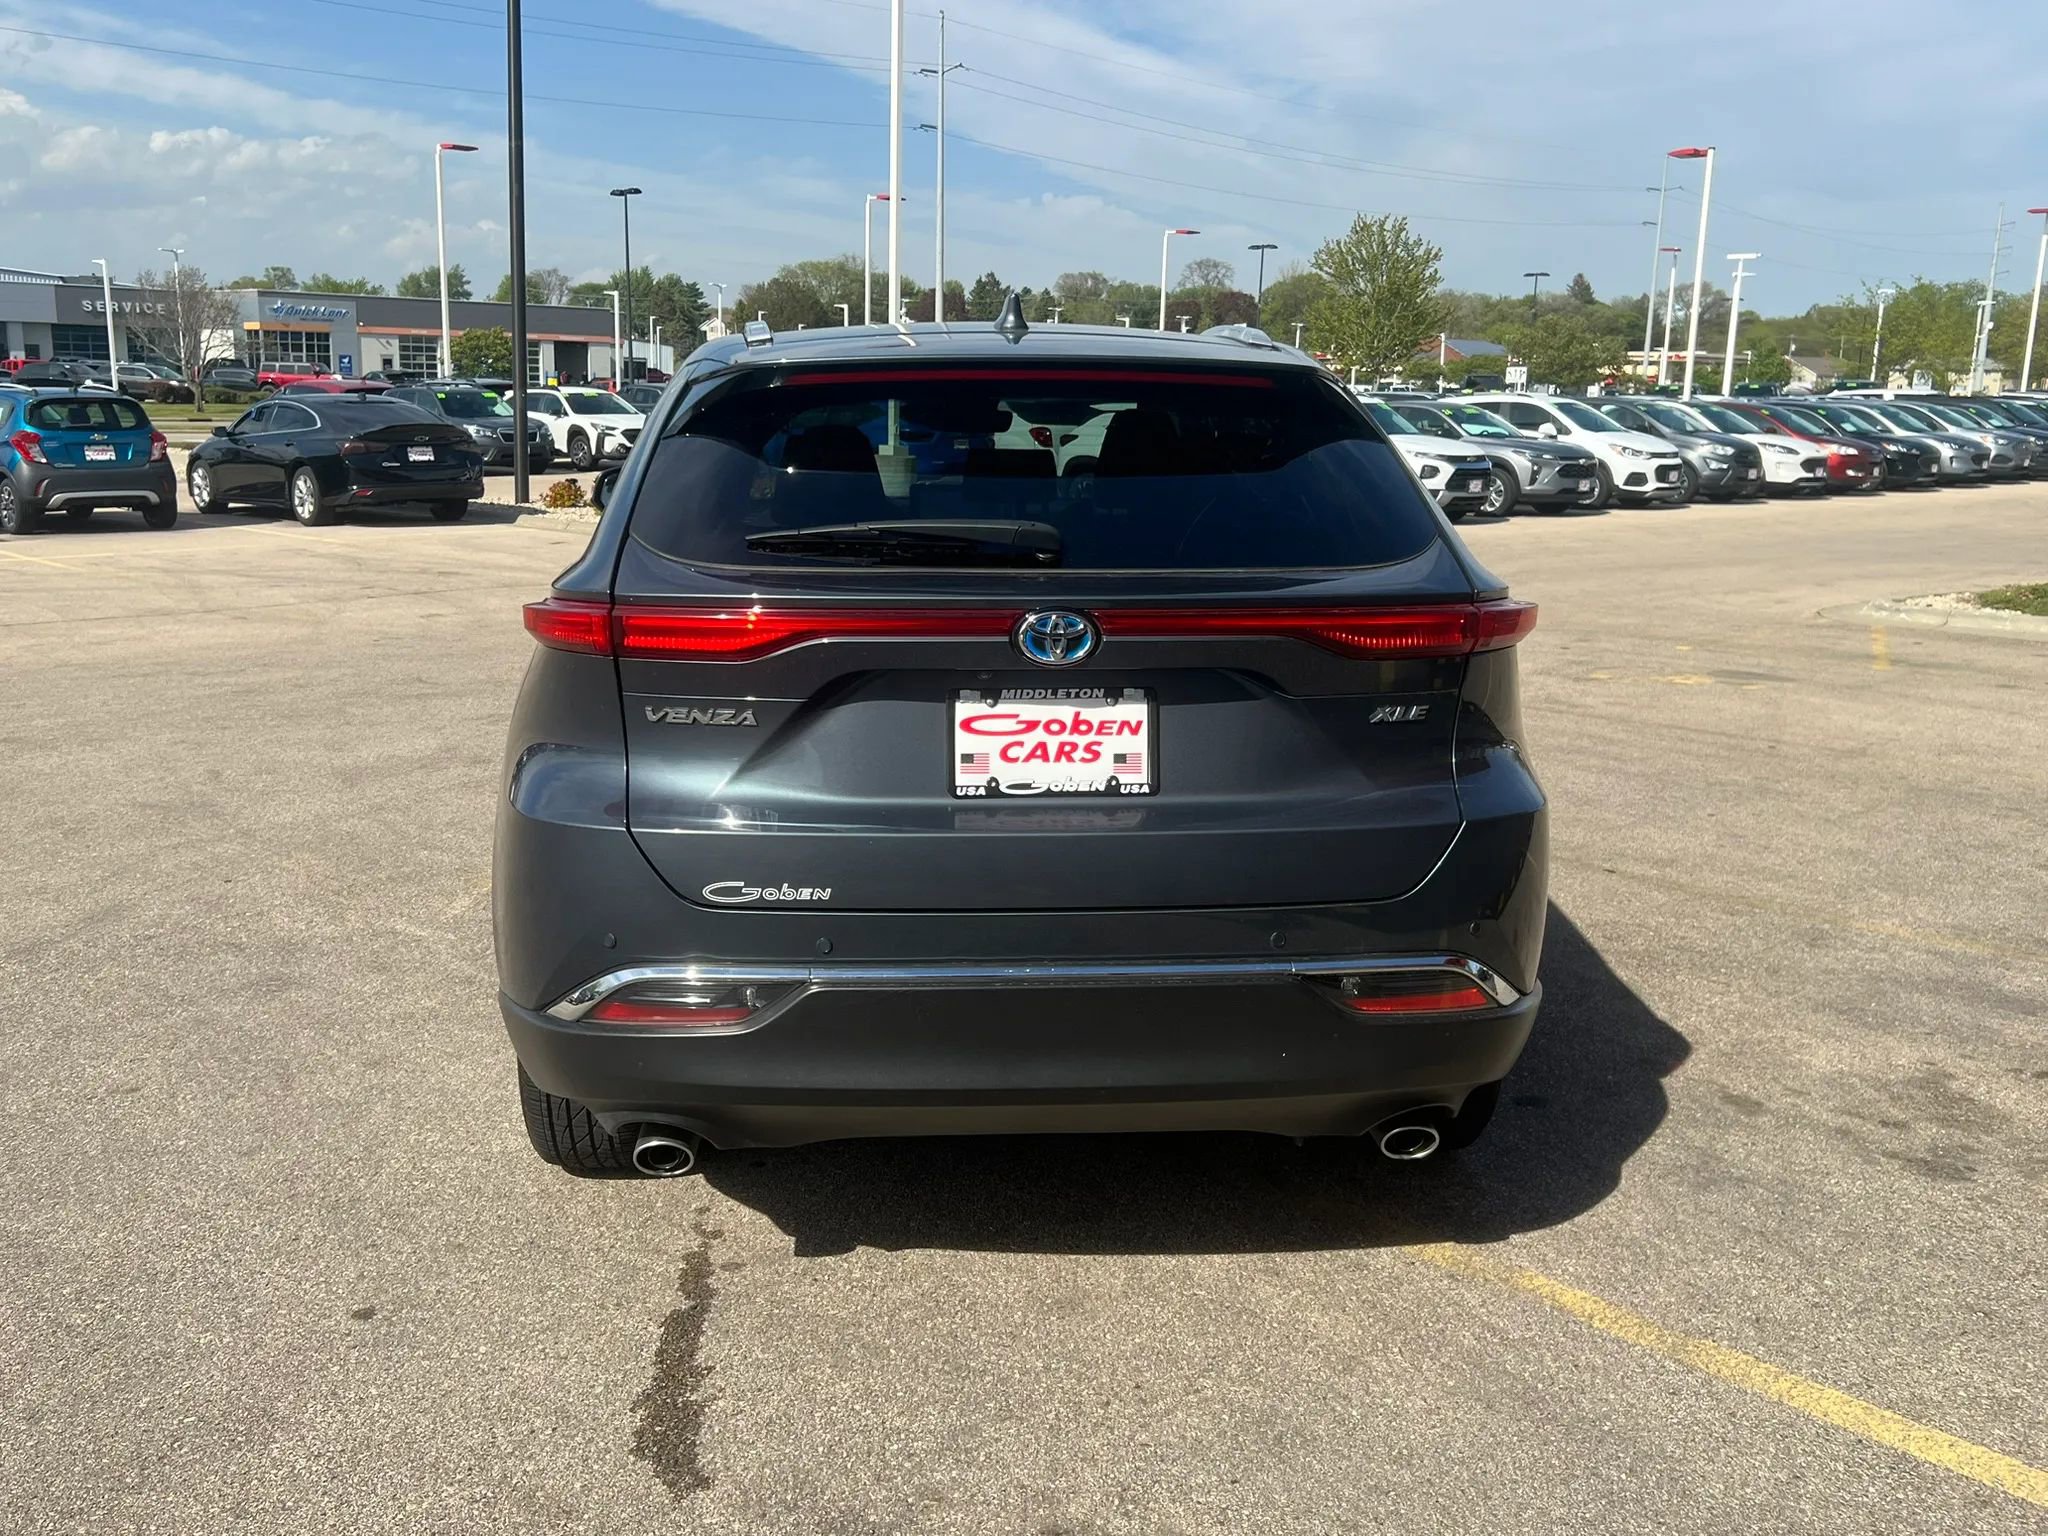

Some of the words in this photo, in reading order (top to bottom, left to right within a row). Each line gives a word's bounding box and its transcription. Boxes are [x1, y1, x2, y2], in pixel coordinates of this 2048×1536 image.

[81, 300, 166, 314] SERVICE
[1000, 688, 1105, 700] MIDDLETON
[645, 706, 758, 727] VENZA
[1368, 705, 1429, 724] XLE
[999, 741, 1104, 764] CARS
[955, 785, 987, 797] USA
[1119, 784, 1151, 795] USA
